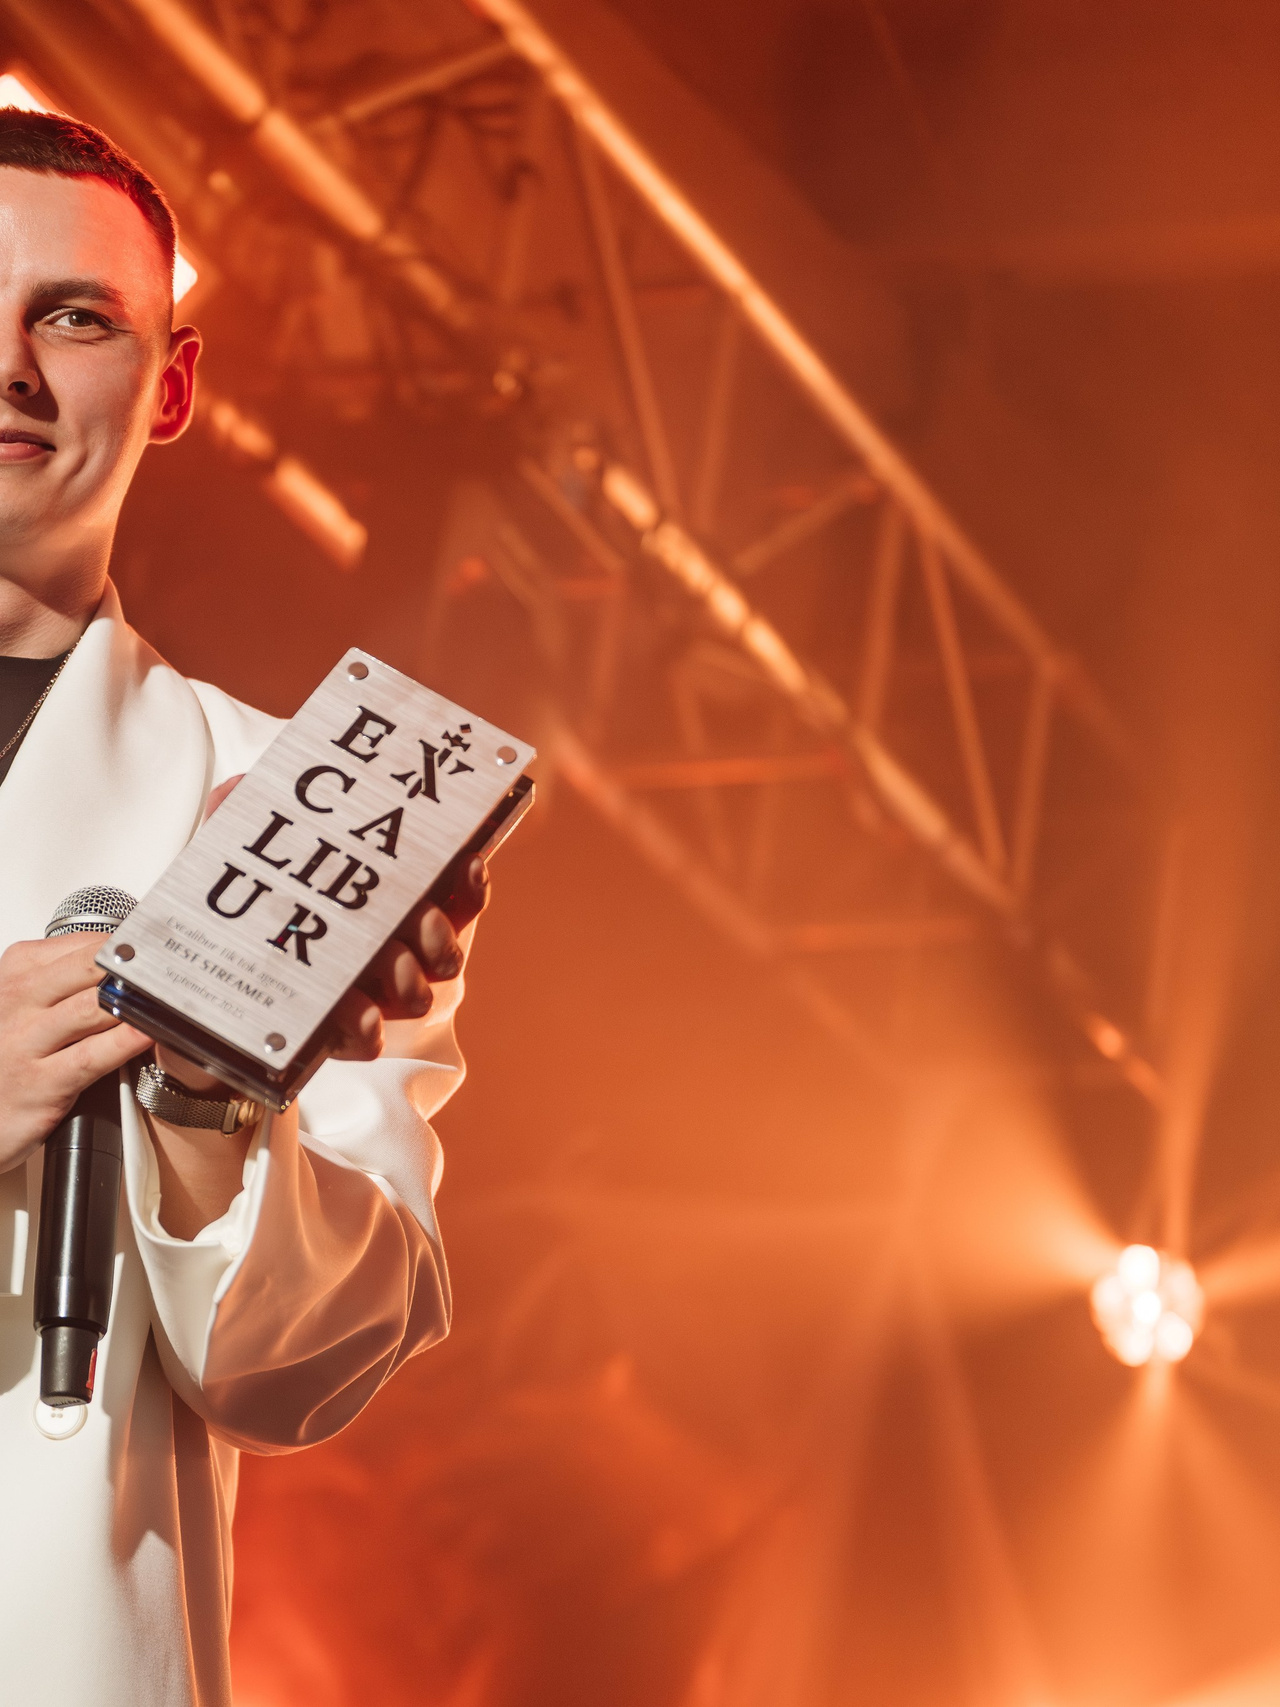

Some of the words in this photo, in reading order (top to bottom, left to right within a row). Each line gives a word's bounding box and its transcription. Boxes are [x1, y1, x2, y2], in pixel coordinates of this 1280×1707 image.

[330, 705, 475, 803] EX
[294, 765, 404, 859] CA
[242, 810, 381, 911] LIB
[166, 915, 219, 950] Excalibur
[257, 971, 298, 998] agency
[206, 862, 329, 967] UR
[164, 938, 199, 963] BEST
[200, 959, 274, 1007] STREAMER
[165, 966, 217, 1003] September
